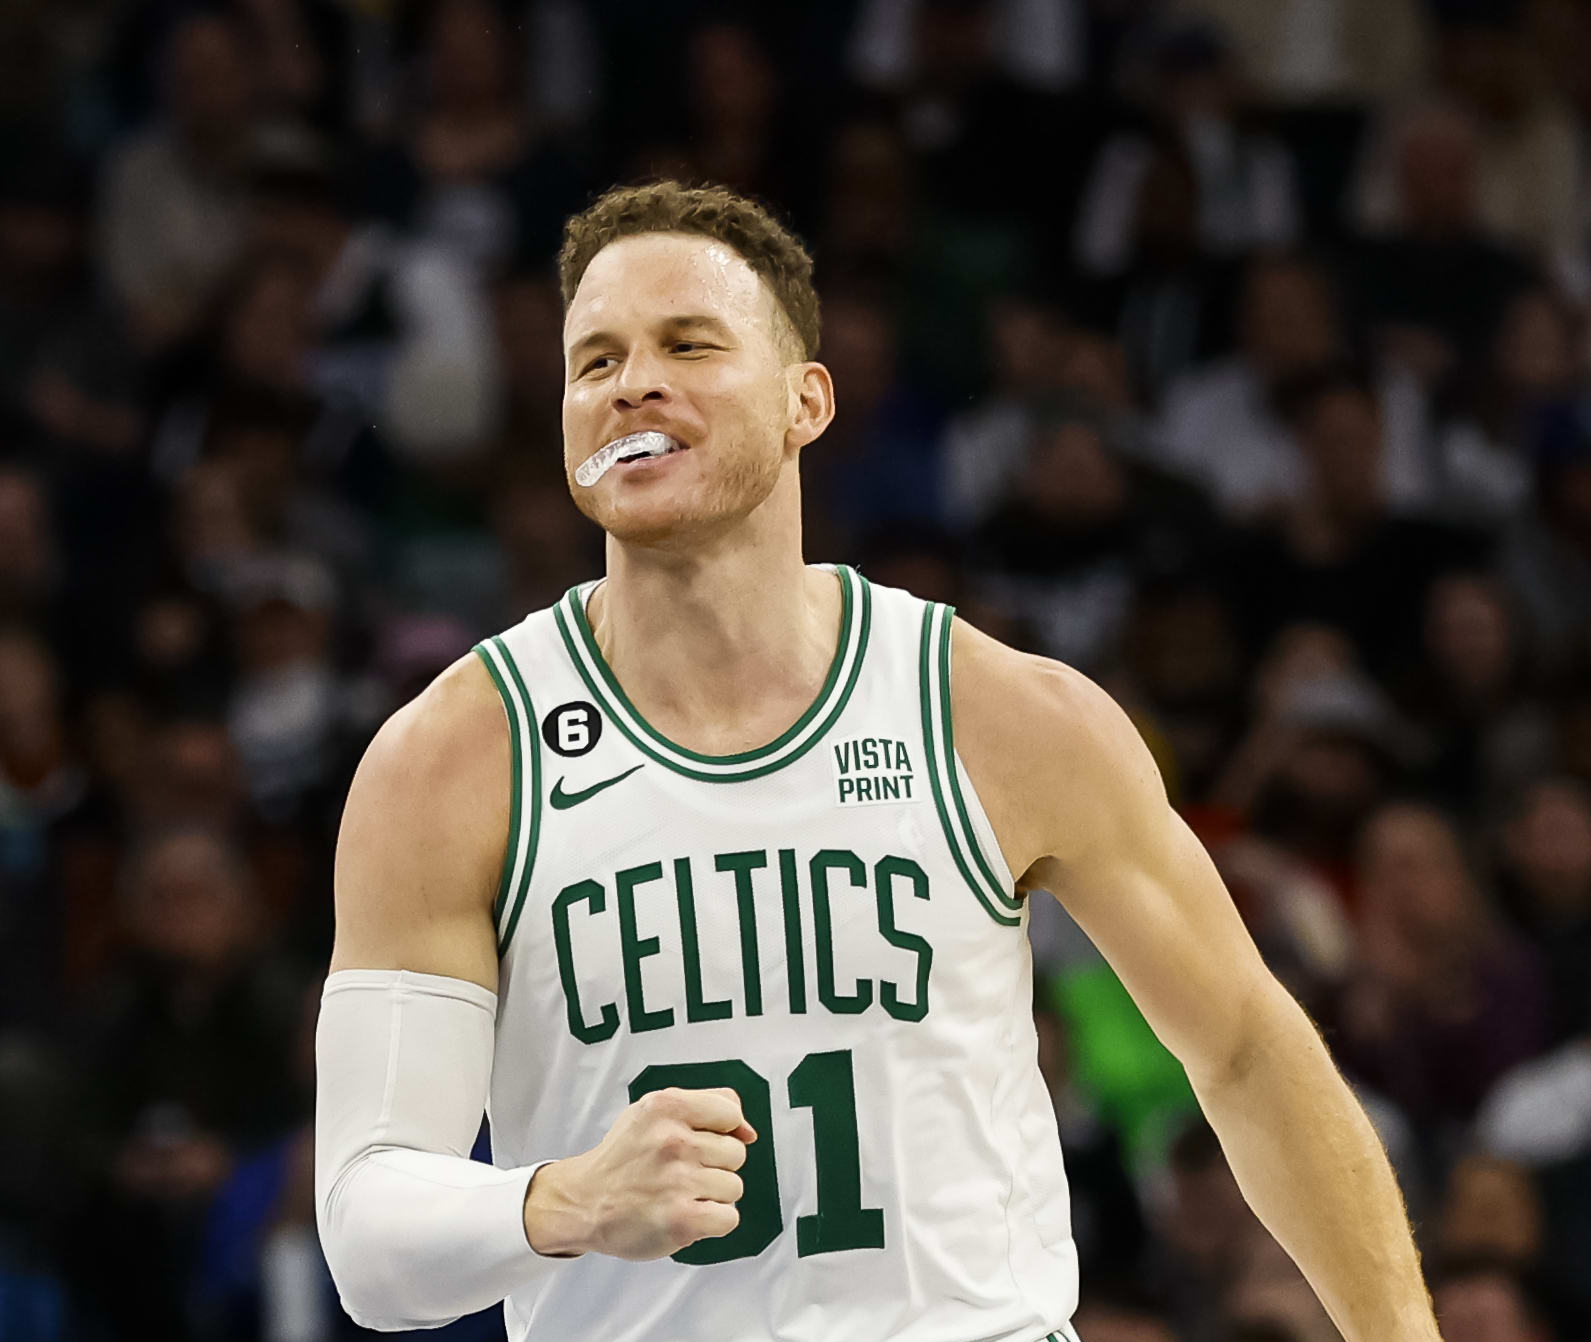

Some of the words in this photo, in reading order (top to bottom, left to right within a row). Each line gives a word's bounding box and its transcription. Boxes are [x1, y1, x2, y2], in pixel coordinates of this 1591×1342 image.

[557, 708, 591, 752] 6
[834, 738, 913, 775] VISTA
[837, 775, 914, 804] PRINT
[551, 848, 933, 1045] CELTICS
